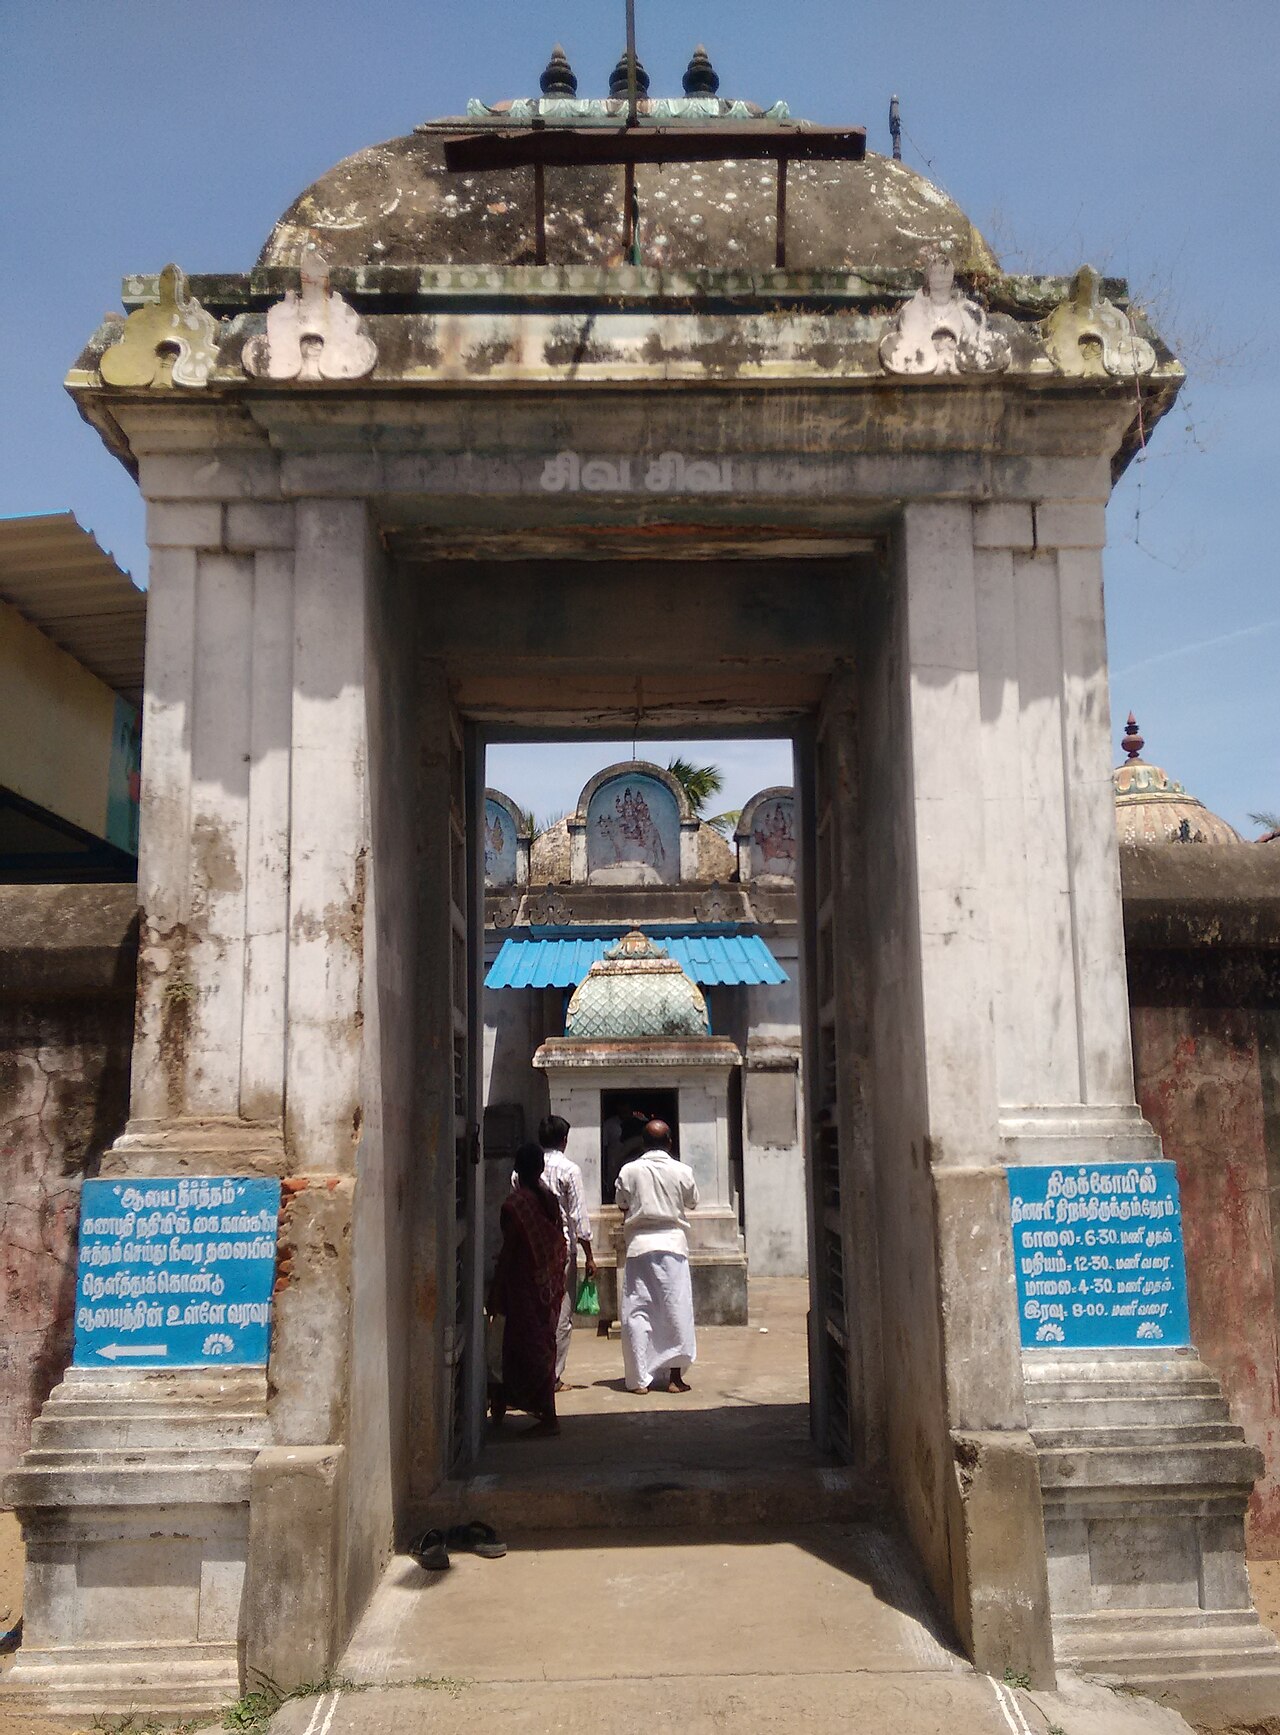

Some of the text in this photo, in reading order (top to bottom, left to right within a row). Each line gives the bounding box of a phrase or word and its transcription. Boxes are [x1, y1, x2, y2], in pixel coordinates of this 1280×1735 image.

[540, 450, 732, 492] சிவ சிவ
[1046, 1166, 1156, 1199] திருக்கோயில்
[79, 1235, 275, 1267] சுத்தம் செய்து நீரை தலையில்
[78, 1301, 164, 1332] ஆலயத்தின்
[167, 1299, 225, 1327] உள்ளே
